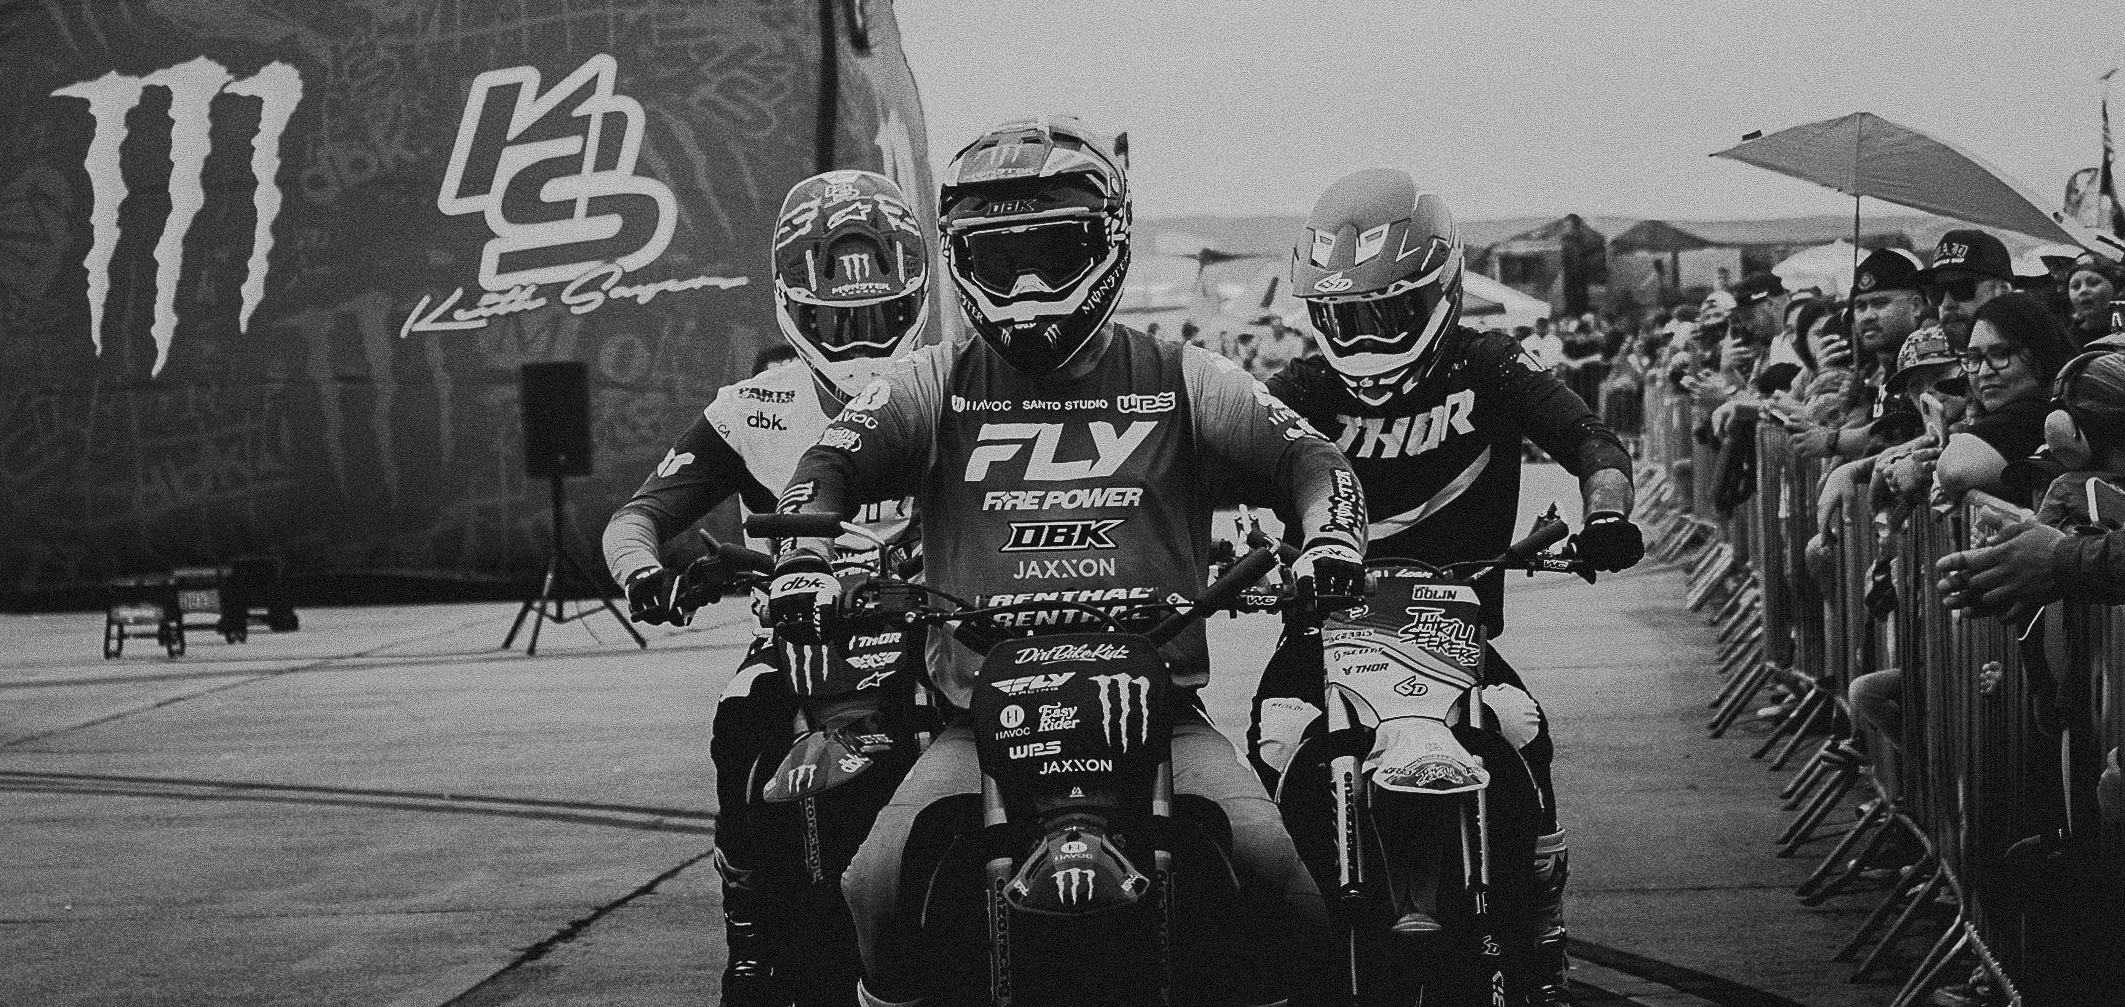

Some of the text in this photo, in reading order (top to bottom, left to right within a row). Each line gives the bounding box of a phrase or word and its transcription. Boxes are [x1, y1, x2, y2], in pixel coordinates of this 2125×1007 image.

[966, 399, 1012, 412] HAVOC
[1022, 399, 1108, 411] SANTO STUDIO
[1117, 392, 1176, 414] WPS
[747, 411, 787, 431] dbk.
[837, 411, 879, 430] VOC
[1336, 388, 1476, 459] THOR
[964, 420, 1159, 482] FLY
[982, 487, 1144, 511] FIRE POWER
[1000, 520, 1126, 552] DBK
[1013, 558, 1116, 580] JAXXON
[988, 587, 1154, 608] RENTHAL
[858, 632, 902, 647] THOR
[1355, 663, 1389, 674] THOR
[1000, 672, 1076, 694] FLY
[1394, 675, 1429, 697] 6D
[1038, 702, 1078, 721] Easy
[995, 727, 1031, 740] HAVOC
[1038, 717, 1080, 732] Rider
[1009, 740, 1062, 759] WPS
[1039, 759, 1113, 775] JAXXON
